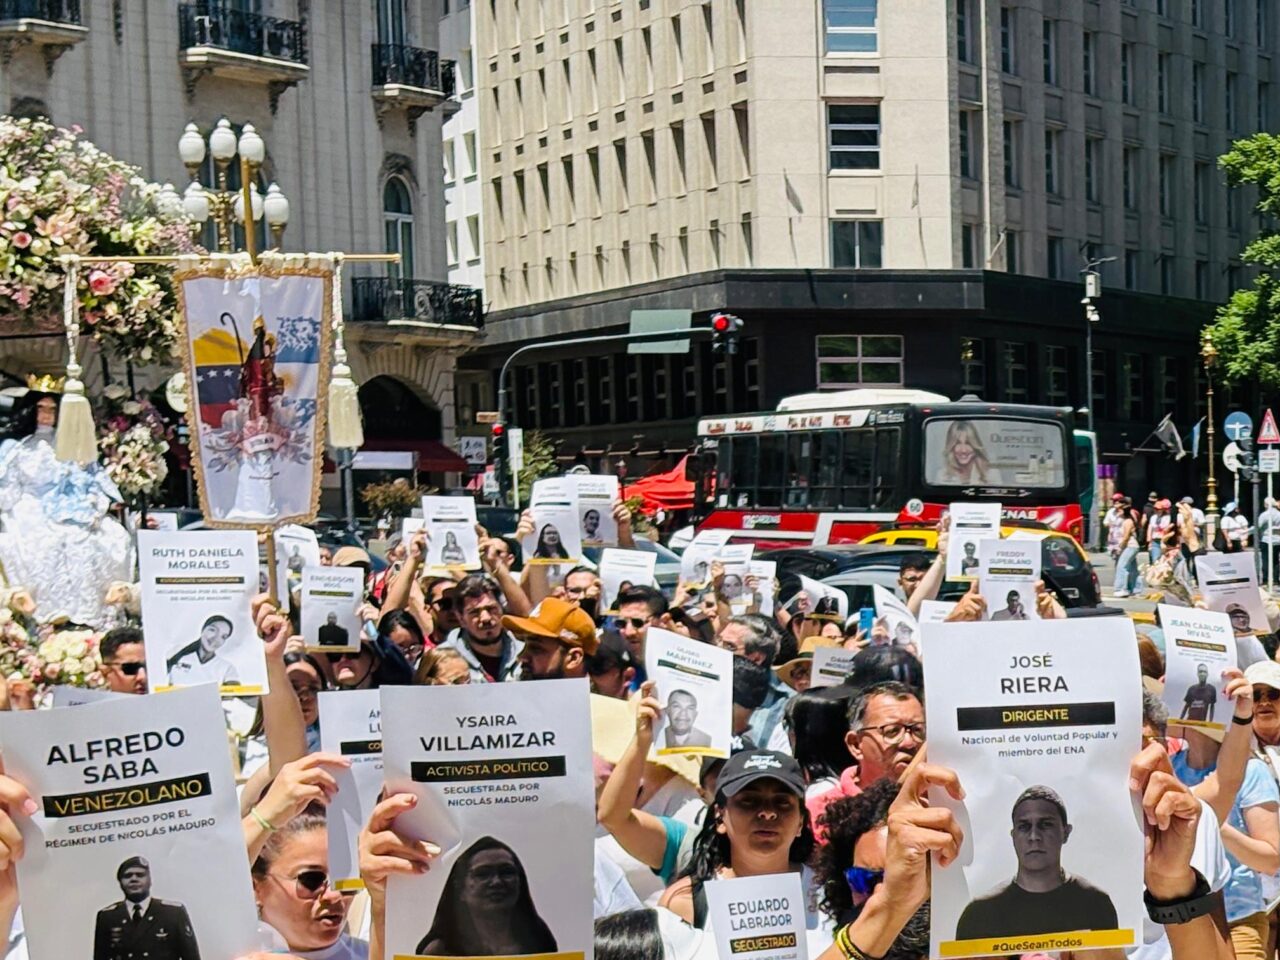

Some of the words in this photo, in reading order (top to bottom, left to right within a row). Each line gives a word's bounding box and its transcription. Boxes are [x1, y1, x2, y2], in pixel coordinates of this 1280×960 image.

[152, 548, 186, 558] RUTH
[188, 548, 244, 558] DANIELA
[168, 560, 230, 570] MORALES
[1170, 619, 1191, 628] JEAN
[1192, 622, 1225, 633] CARLOS
[1186, 630, 1212, 638] RIVAS
[1010, 652, 1052, 668] JOSÉ
[1001, 676, 1069, 694] RIERA
[456, 714, 518, 728] YSAIRA
[1002, 708, 1069, 722] DIRIGENTE
[420, 731, 556, 752] VILLAMIZAR
[962, 734, 1006, 744] Nacional
[1008, 734, 1022, 743] de
[1024, 732, 1070, 742] Voluntad
[1072, 730, 1110, 742] Popular
[1112, 732, 1118, 740] y
[46, 727, 185, 766] ALFREDO
[998, 748, 1044, 758] miembro
[1046, 746, 1062, 756] del
[1064, 746, 1086, 754] ENA
[83, 757, 158, 784] SABA
[426, 763, 490, 776] ACTIVISTA
[493, 761, 550, 774] POLÍTICO
[444, 784, 516, 794] SECUESTRADA
[518, 782, 540, 792] POR
[54, 779, 202, 816] VENEZOLANO
[448, 796, 492, 806] NICOLÁS
[494, 795, 539, 804] MADURO
[68, 816, 150, 834] SECUESTRADO
[152, 812, 176, 822] POR
[178, 808, 192, 818] EL
[45, 835, 96, 848] RÉGIMEN
[98, 834, 116, 844] DE
[117, 826, 166, 841] NICOLÁS
[168, 818, 216, 834] MADURO
[728, 898, 790, 916] EDUARDO
[730, 914, 792, 932] LABRADOR
[734, 934, 795, 952] SECUESTRADO
[992, 938, 1082, 952] #QueSeanTodos
